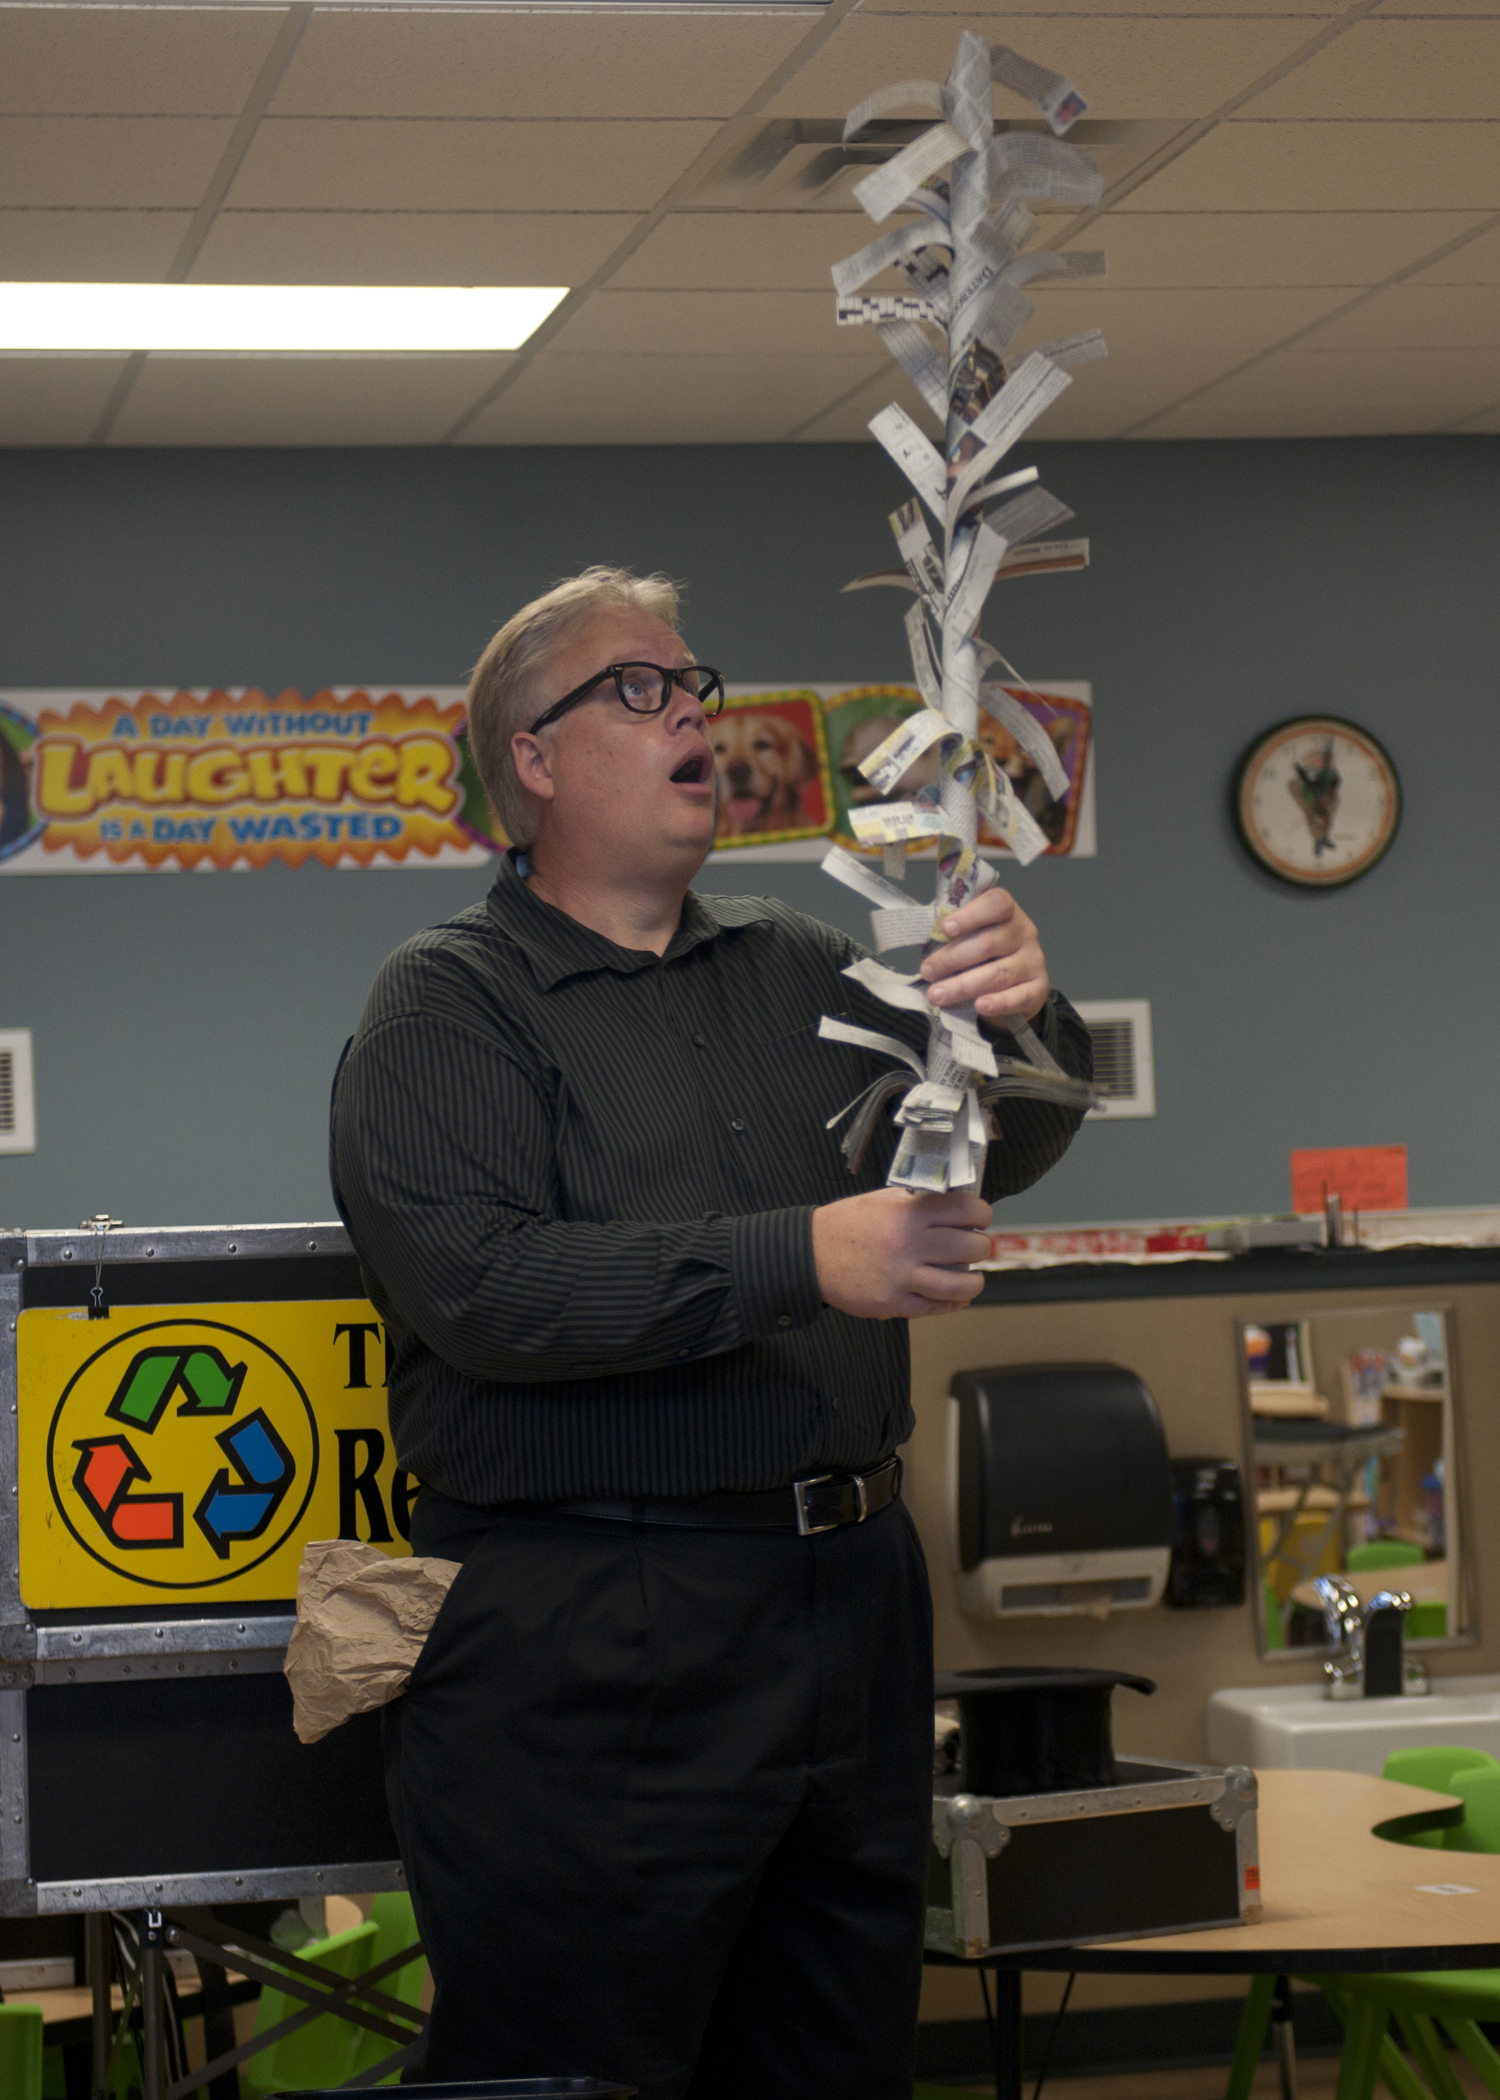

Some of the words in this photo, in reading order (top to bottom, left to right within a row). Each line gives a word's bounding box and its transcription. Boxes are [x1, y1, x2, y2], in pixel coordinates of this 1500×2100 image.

[112, 713, 139, 738] A
[149, 713, 212, 738] DAY
[224, 710, 375, 737] WITHOUT
[39, 738, 457, 816] LAUGHTER
[99, 817, 122, 840] IS
[129, 818, 149, 840] A
[153, 816, 216, 842] DAY
[228, 812, 403, 841] WASTED
